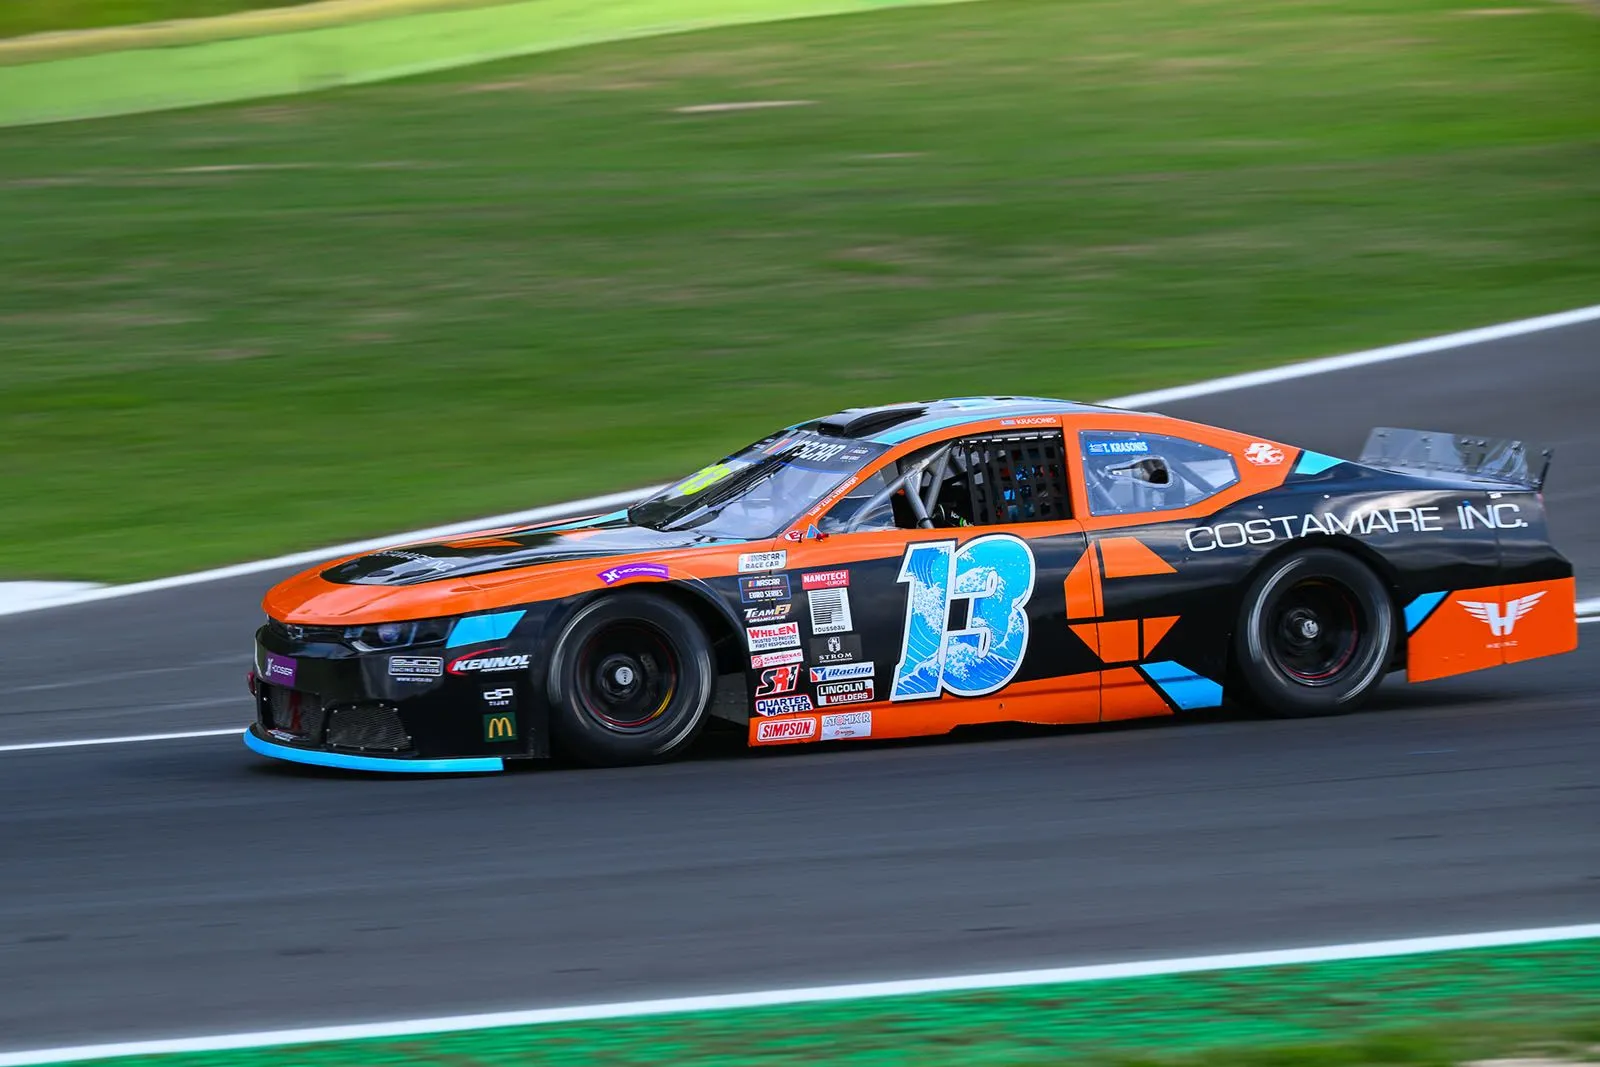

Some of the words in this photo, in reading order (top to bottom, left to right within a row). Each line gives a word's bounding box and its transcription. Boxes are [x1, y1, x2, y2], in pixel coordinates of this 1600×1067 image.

[1015, 417, 1057, 425] KRASONIS
[1109, 441, 1148, 453] KRASONIS
[1185, 506, 1443, 552] COSTAMARE
[1457, 503, 1529, 531] INC.
[751, 553, 780, 561] NASCAR
[756, 578, 781, 588] NASCAR
[803, 571, 847, 583] NANOTECH
[749, 591, 764, 599] EURO
[765, 589, 784, 598] SERIES
[889, 532, 1036, 702] 13
[748, 624, 797, 639] WHELEN
[814, 625, 846, 633] rousseau
[768, 640, 797, 648] RESPONDERS
[452, 655, 530, 672] KENNOL
[828, 666, 873, 676] iRacing
[820, 682, 863, 696] LINCOLN
[830, 692, 869, 703] WELDERS
[757, 696, 808, 712] QUARTER
[767, 702, 811, 716] MASTER
[762, 721, 811, 738] SIMPSON
